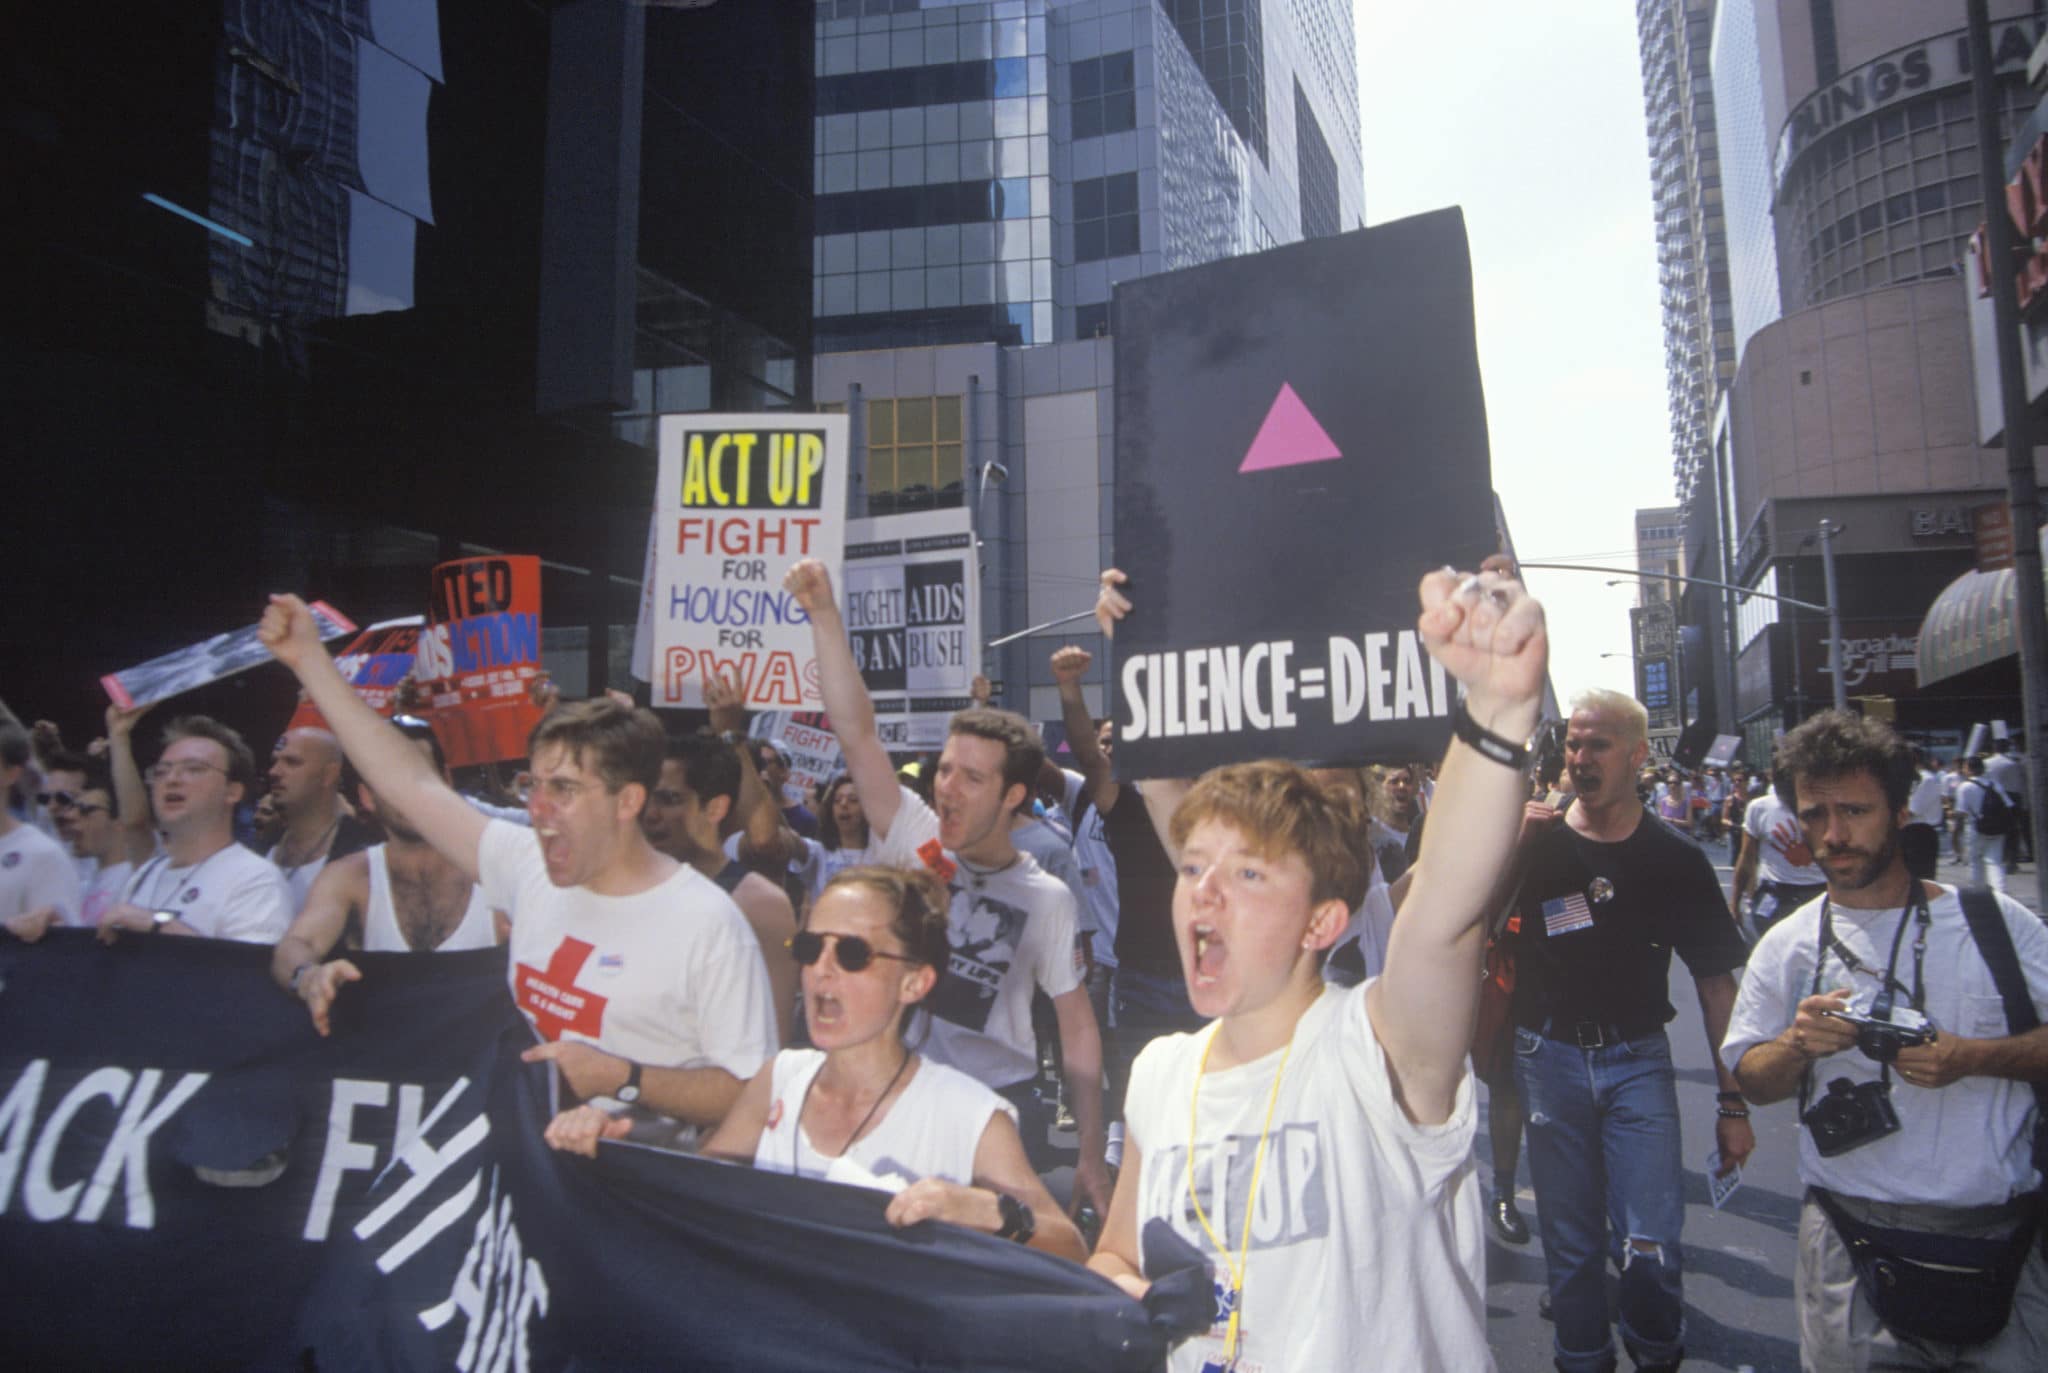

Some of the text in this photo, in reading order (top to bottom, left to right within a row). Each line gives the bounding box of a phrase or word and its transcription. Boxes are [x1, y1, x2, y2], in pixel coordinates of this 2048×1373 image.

[682, 432, 825, 506] ACT UP
[677, 518, 821, 555] FIGHT
[722, 560, 766, 581] FOR
[669, 585, 813, 626] HOUSING
[847, 582, 963, 627] FIGHT AIDS
[450, 611, 538, 673] ACTION
[719, 629, 764, 649] FOR
[852, 631, 963, 672] BAN BUSH
[1121, 629, 1467, 742] SILENCE=DEAT
[783, 724, 833, 752] FIGHT
[1148, 1129, 1317, 1247] ACT UP
